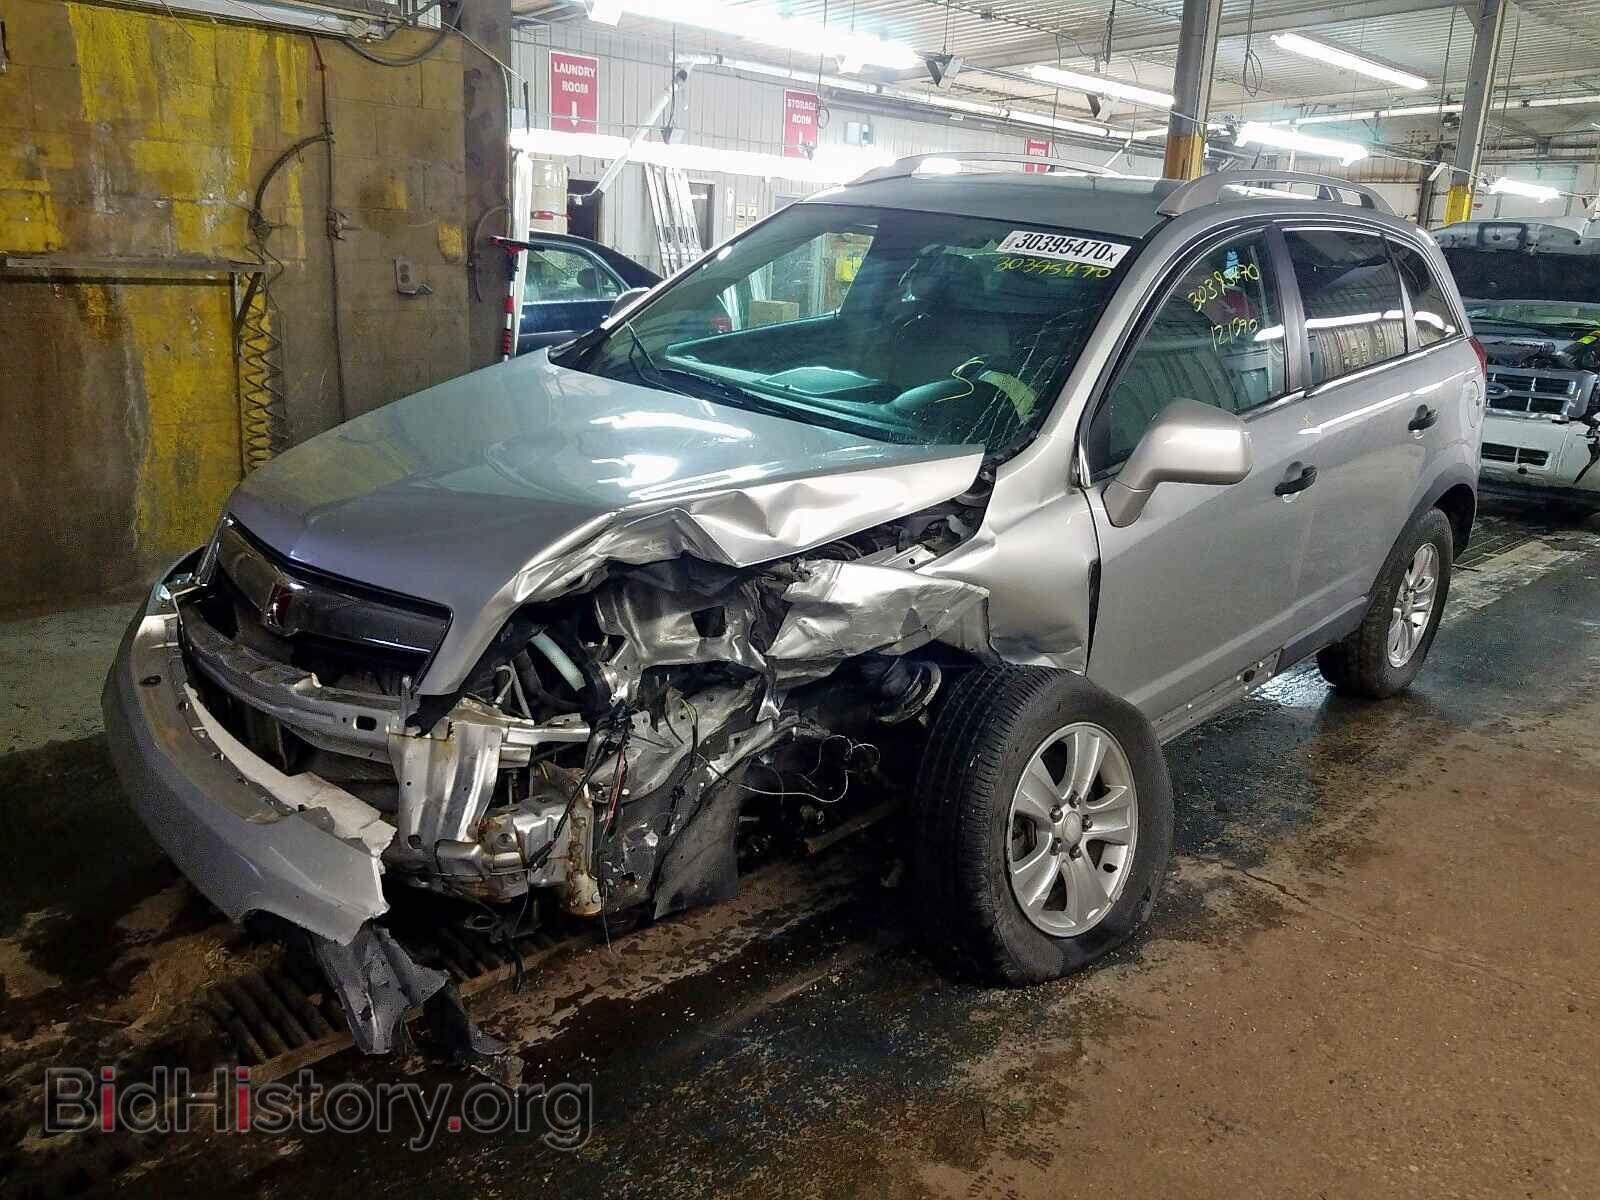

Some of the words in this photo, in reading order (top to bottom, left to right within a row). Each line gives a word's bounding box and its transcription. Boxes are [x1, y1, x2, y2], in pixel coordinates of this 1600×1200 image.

[554, 62, 596, 78] LAUNDRY
[562, 80, 588, 94] ROOM
[792, 113, 811, 125] ROOM
[997, 257, 1112, 279] 30395470
